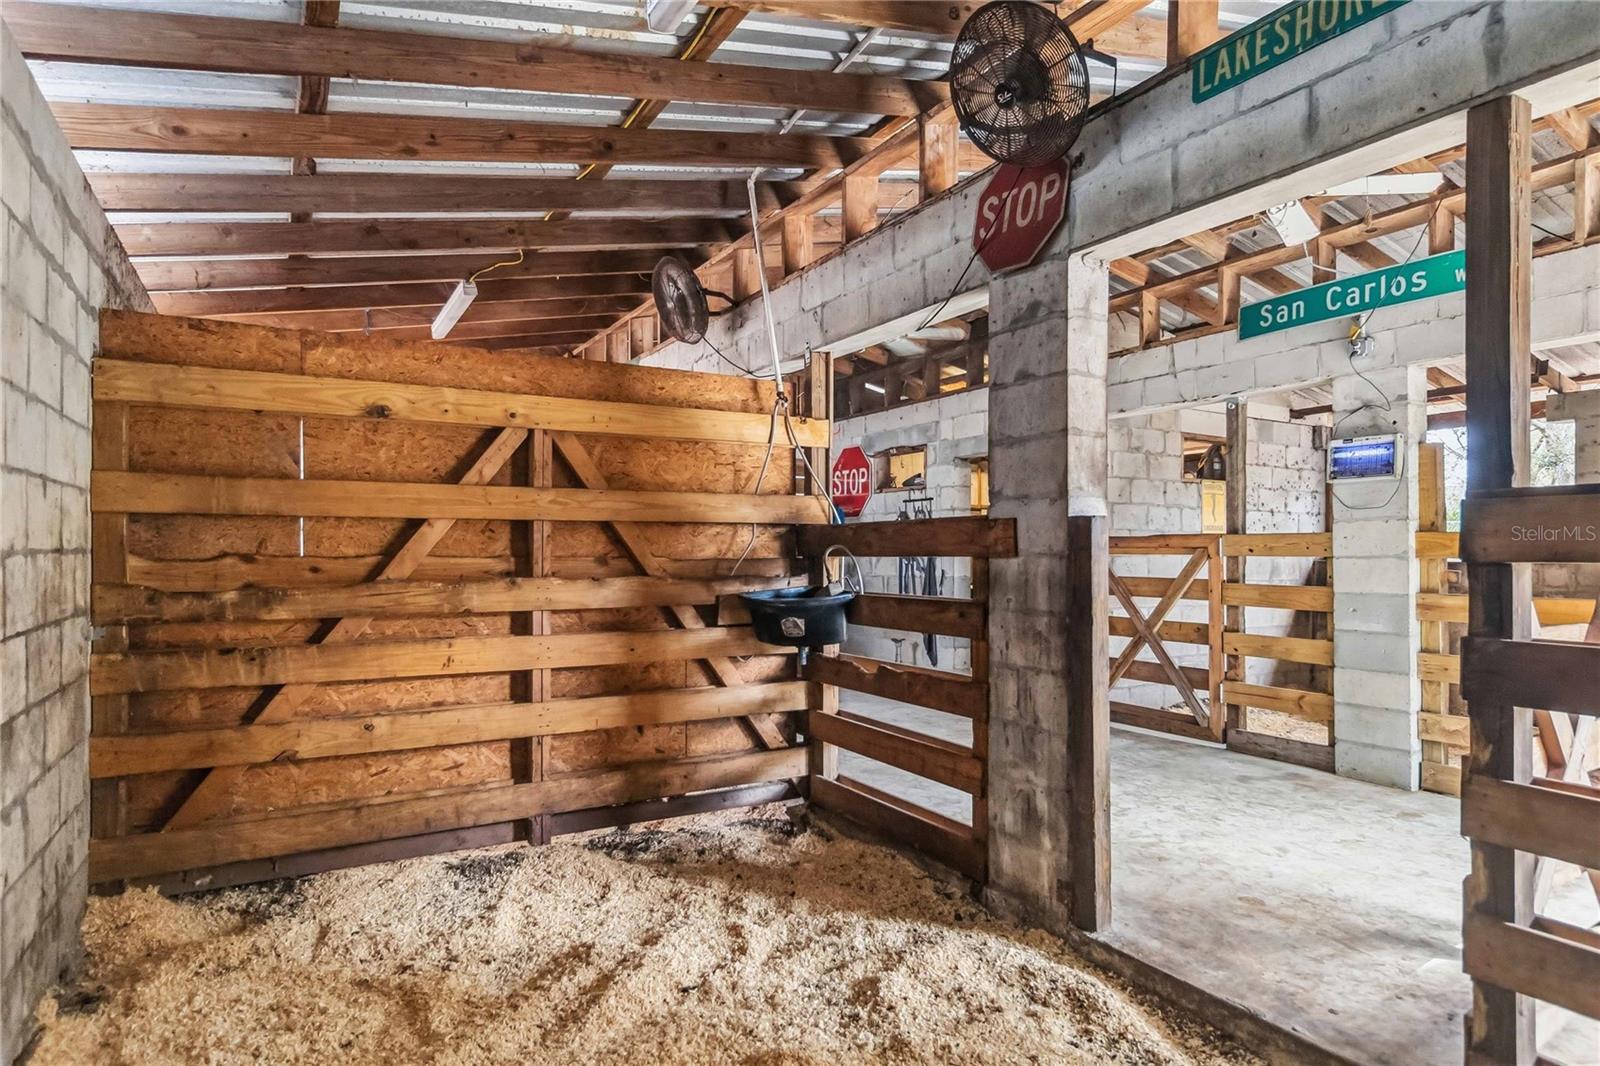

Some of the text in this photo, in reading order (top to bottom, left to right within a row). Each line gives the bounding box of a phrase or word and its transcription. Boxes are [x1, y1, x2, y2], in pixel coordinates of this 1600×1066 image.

[979, 172, 1061, 239] STOP
[1259, 300, 1305, 328] San
[1326, 270, 1428, 312] Carlos
[833, 467, 868, 496] STOP
